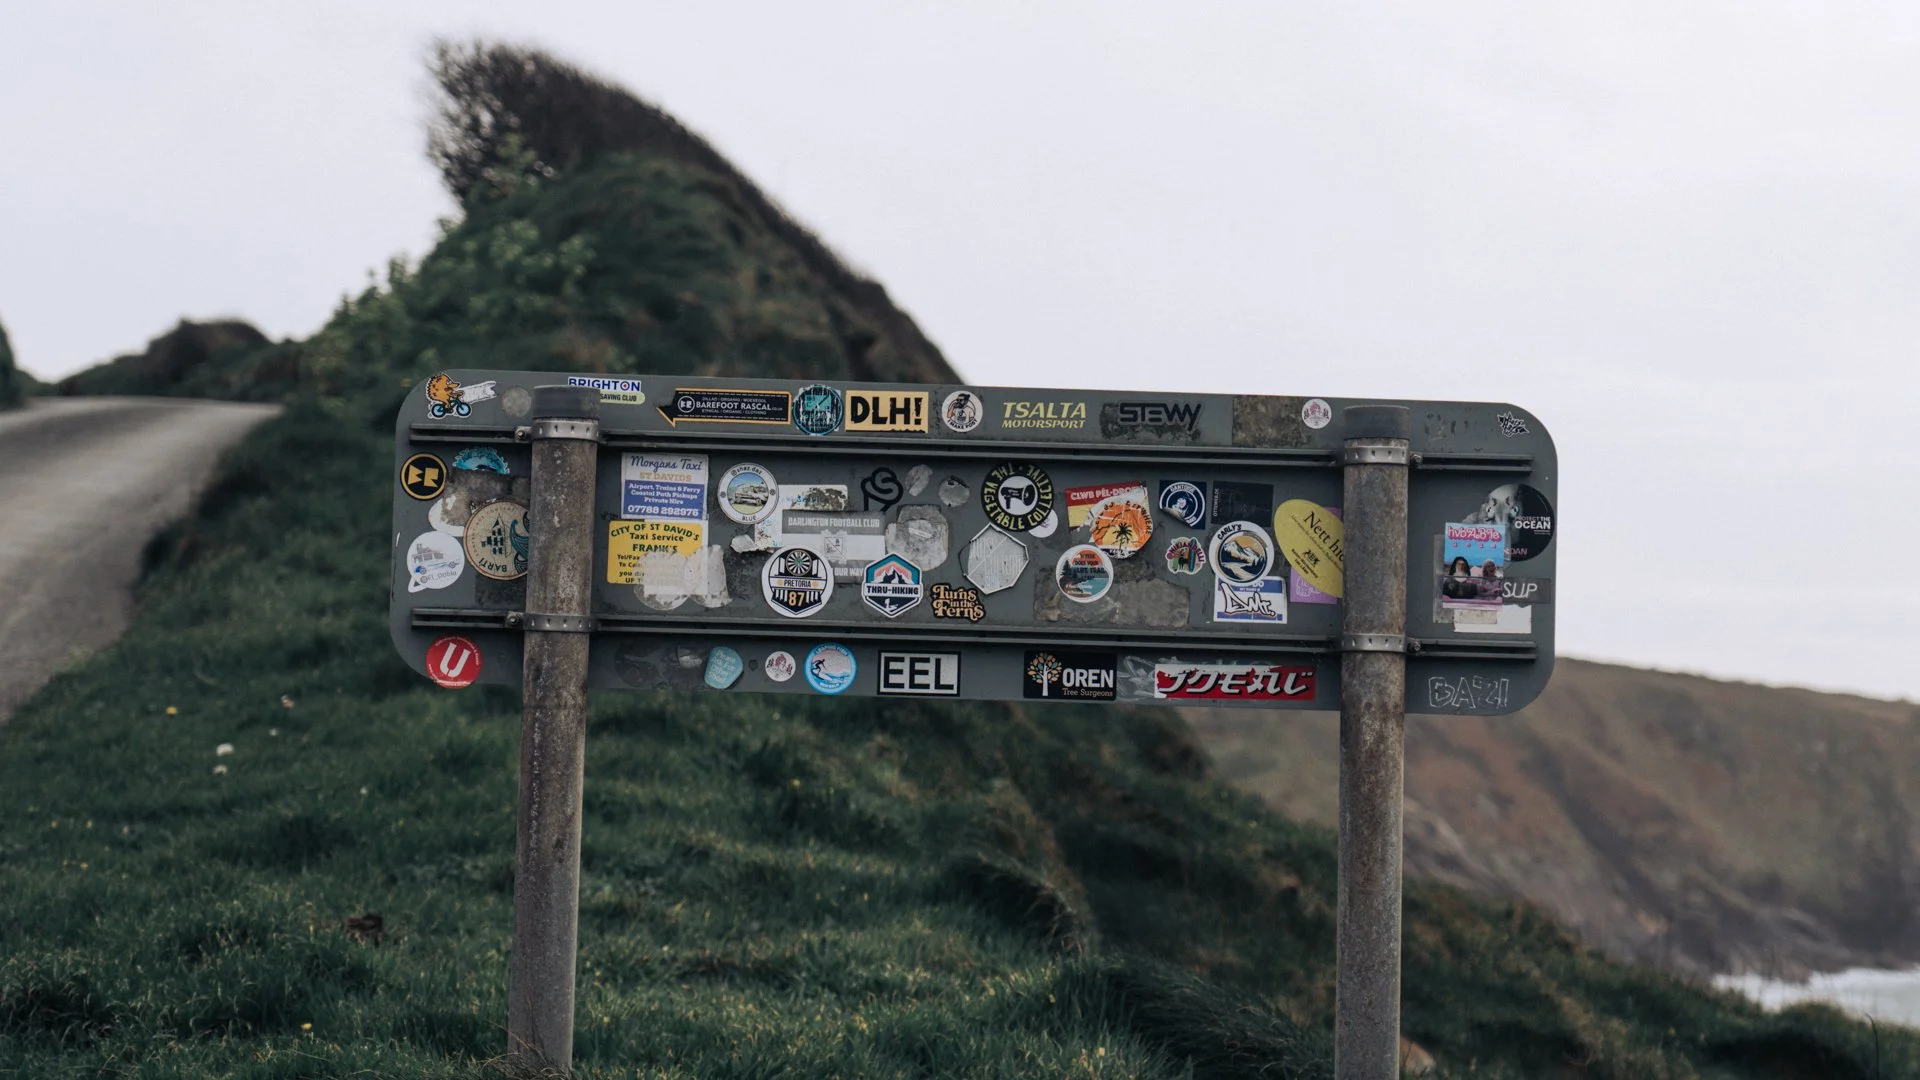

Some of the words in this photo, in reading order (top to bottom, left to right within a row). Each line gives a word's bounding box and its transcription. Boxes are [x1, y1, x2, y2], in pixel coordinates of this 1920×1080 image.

[569, 378, 640, 391] BRIGHTON
[696, 401, 739, 409] BAREFOOT
[851, 396, 923, 425] DLH!
[1003, 402, 1086, 419] TSALTA
[1001, 419, 1086, 429] MOTORSPORT
[629, 456, 677, 472] Morgans
[681, 459, 703, 470] Taxi
[991, 462, 1016, 481] THE
[653, 473, 693, 482] DAVIDS
[683, 487, 701, 495] Ferry
[1026, 464, 1053, 527] COLLECTIVE
[1070, 489, 1095, 500] CLWB
[644, 497, 668, 505] Private
[672, 493, 698, 501] Pickups
[627, 505, 660, 514] 07788
[983, 481, 1026, 530] VEGETABLE
[788, 517, 829, 527] DARLINGTON
[829, 518, 861, 527] FOOTBALL
[863, 519, 880, 528] CLUB
[1303, 511, 1330, 543] Nett
[1514, 520, 1551, 530] OCEAN
[611, 525, 631, 537] CITY
[634, 523, 646, 531] OF
[650, 523, 661, 531] ST
[663, 524, 700, 541] DAVID'S
[630, 532, 649, 540] Taxi
[652, 533, 684, 542] Service
[1217, 524, 1242, 540] CARLY'S
[834, 568, 848, 577] OUR
[849, 568, 864, 577] WAY
[784, 580, 812, 588] PRETORIA
[866, 586, 919, 595] THRU-HIKING
[932, 584, 977, 602] Turns
[788, 591, 805, 607] 87
[950, 598, 960, 607] in
[960, 599, 976, 608] the
[932, 600, 985, 621] Ferns
[883, 656, 955, 690] EEL
[1062, 667, 1114, 688] OREN
[1062, 687, 1079, 695] Tree
[1080, 689, 1114, 697] Surgeons
